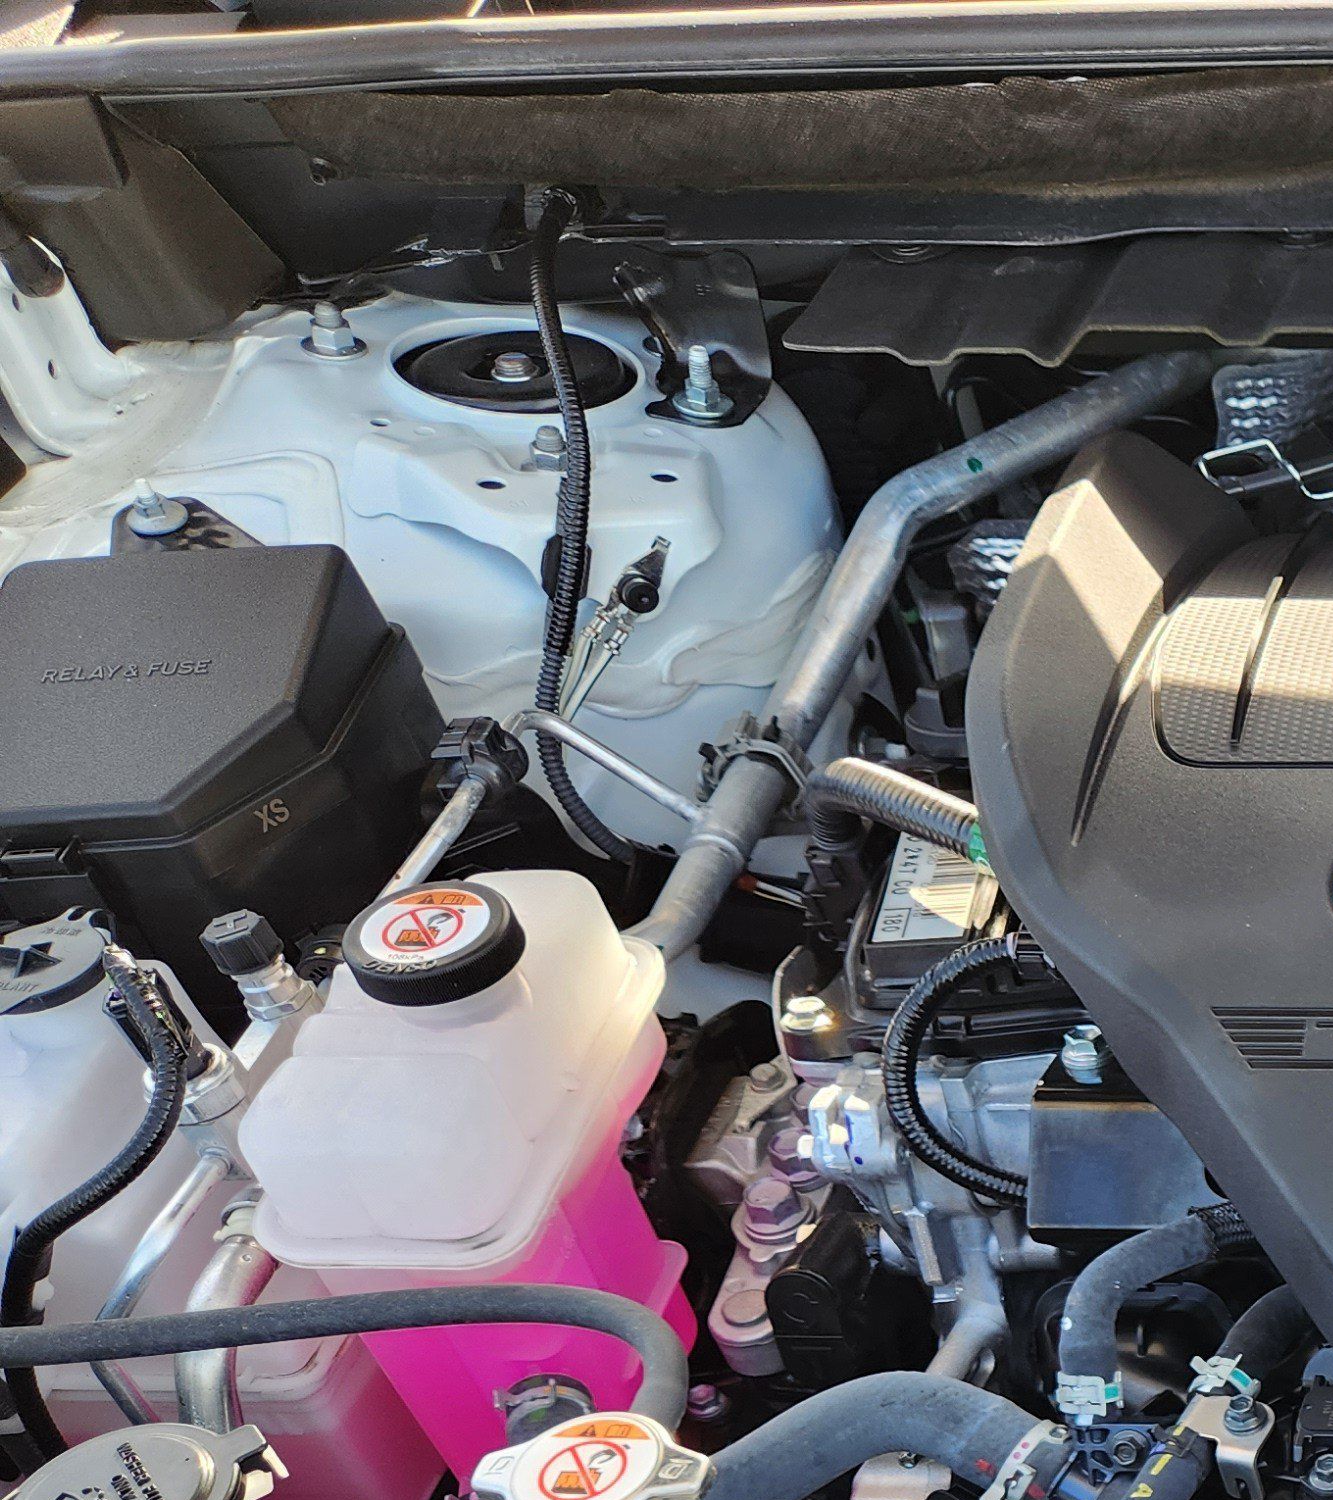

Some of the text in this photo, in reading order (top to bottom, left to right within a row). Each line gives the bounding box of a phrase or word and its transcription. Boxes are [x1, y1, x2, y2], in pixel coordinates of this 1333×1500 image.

[40, 659, 212, 684] RELAY & FUSE
[253, 797, 290, 834] XS
[881, 913, 904, 934] 180
[362, 959, 439, 975] DENSO
[117, 1441, 152, 1487] WASHER
